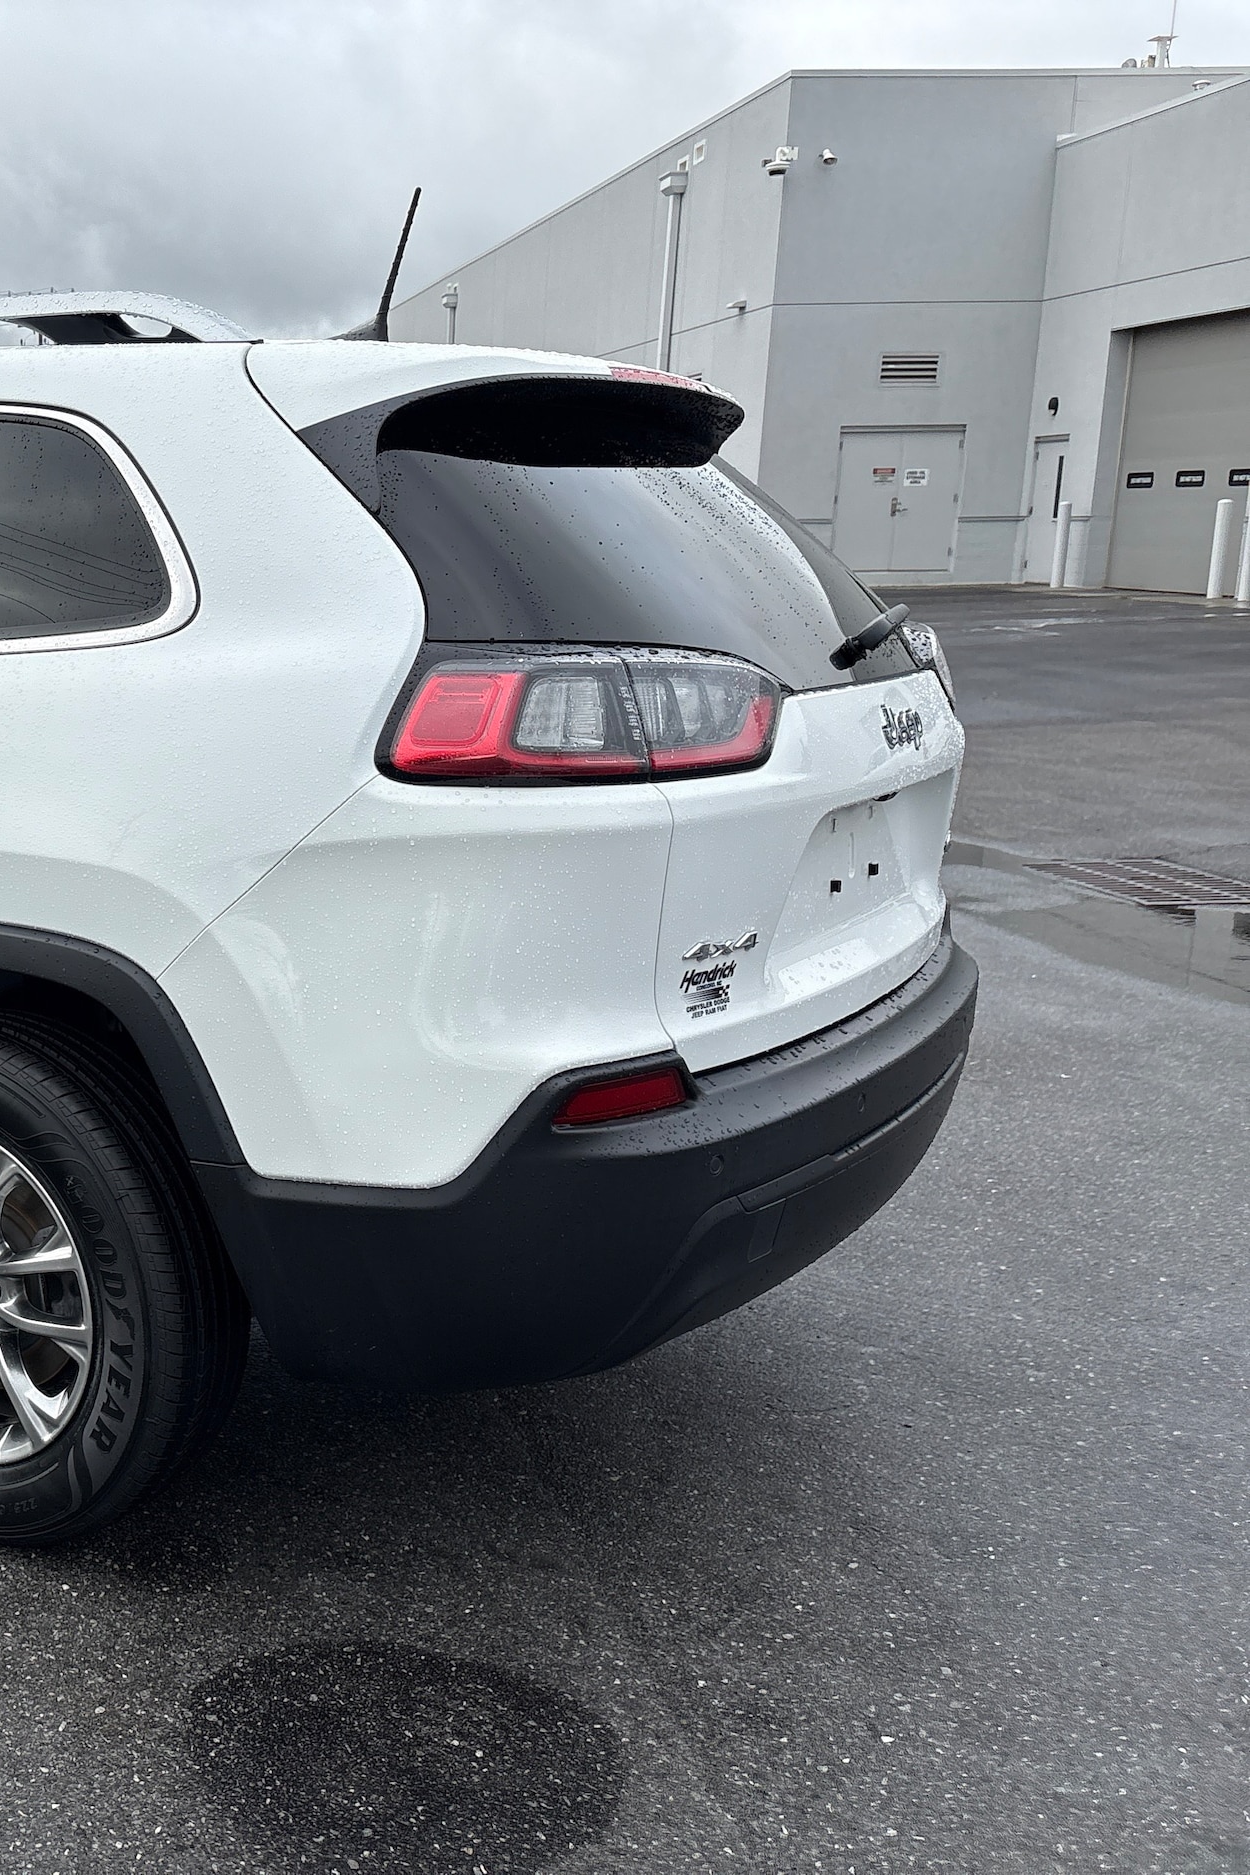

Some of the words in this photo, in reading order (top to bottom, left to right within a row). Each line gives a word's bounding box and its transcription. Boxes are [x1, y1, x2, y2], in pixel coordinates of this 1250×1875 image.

[880, 704, 924, 751] Jeep
[679, 959, 738, 994] Hendrick
[686, 1002, 712, 1012] CHRYSLER
[713, 997, 730, 1006] DODGE
[691, 1010, 704, 1019] JEEP
[705, 1007, 717, 1016] RAM
[717, 1004, 728, 1013] FIAT
[65, 1174, 136, 1456] GOODYEAR
